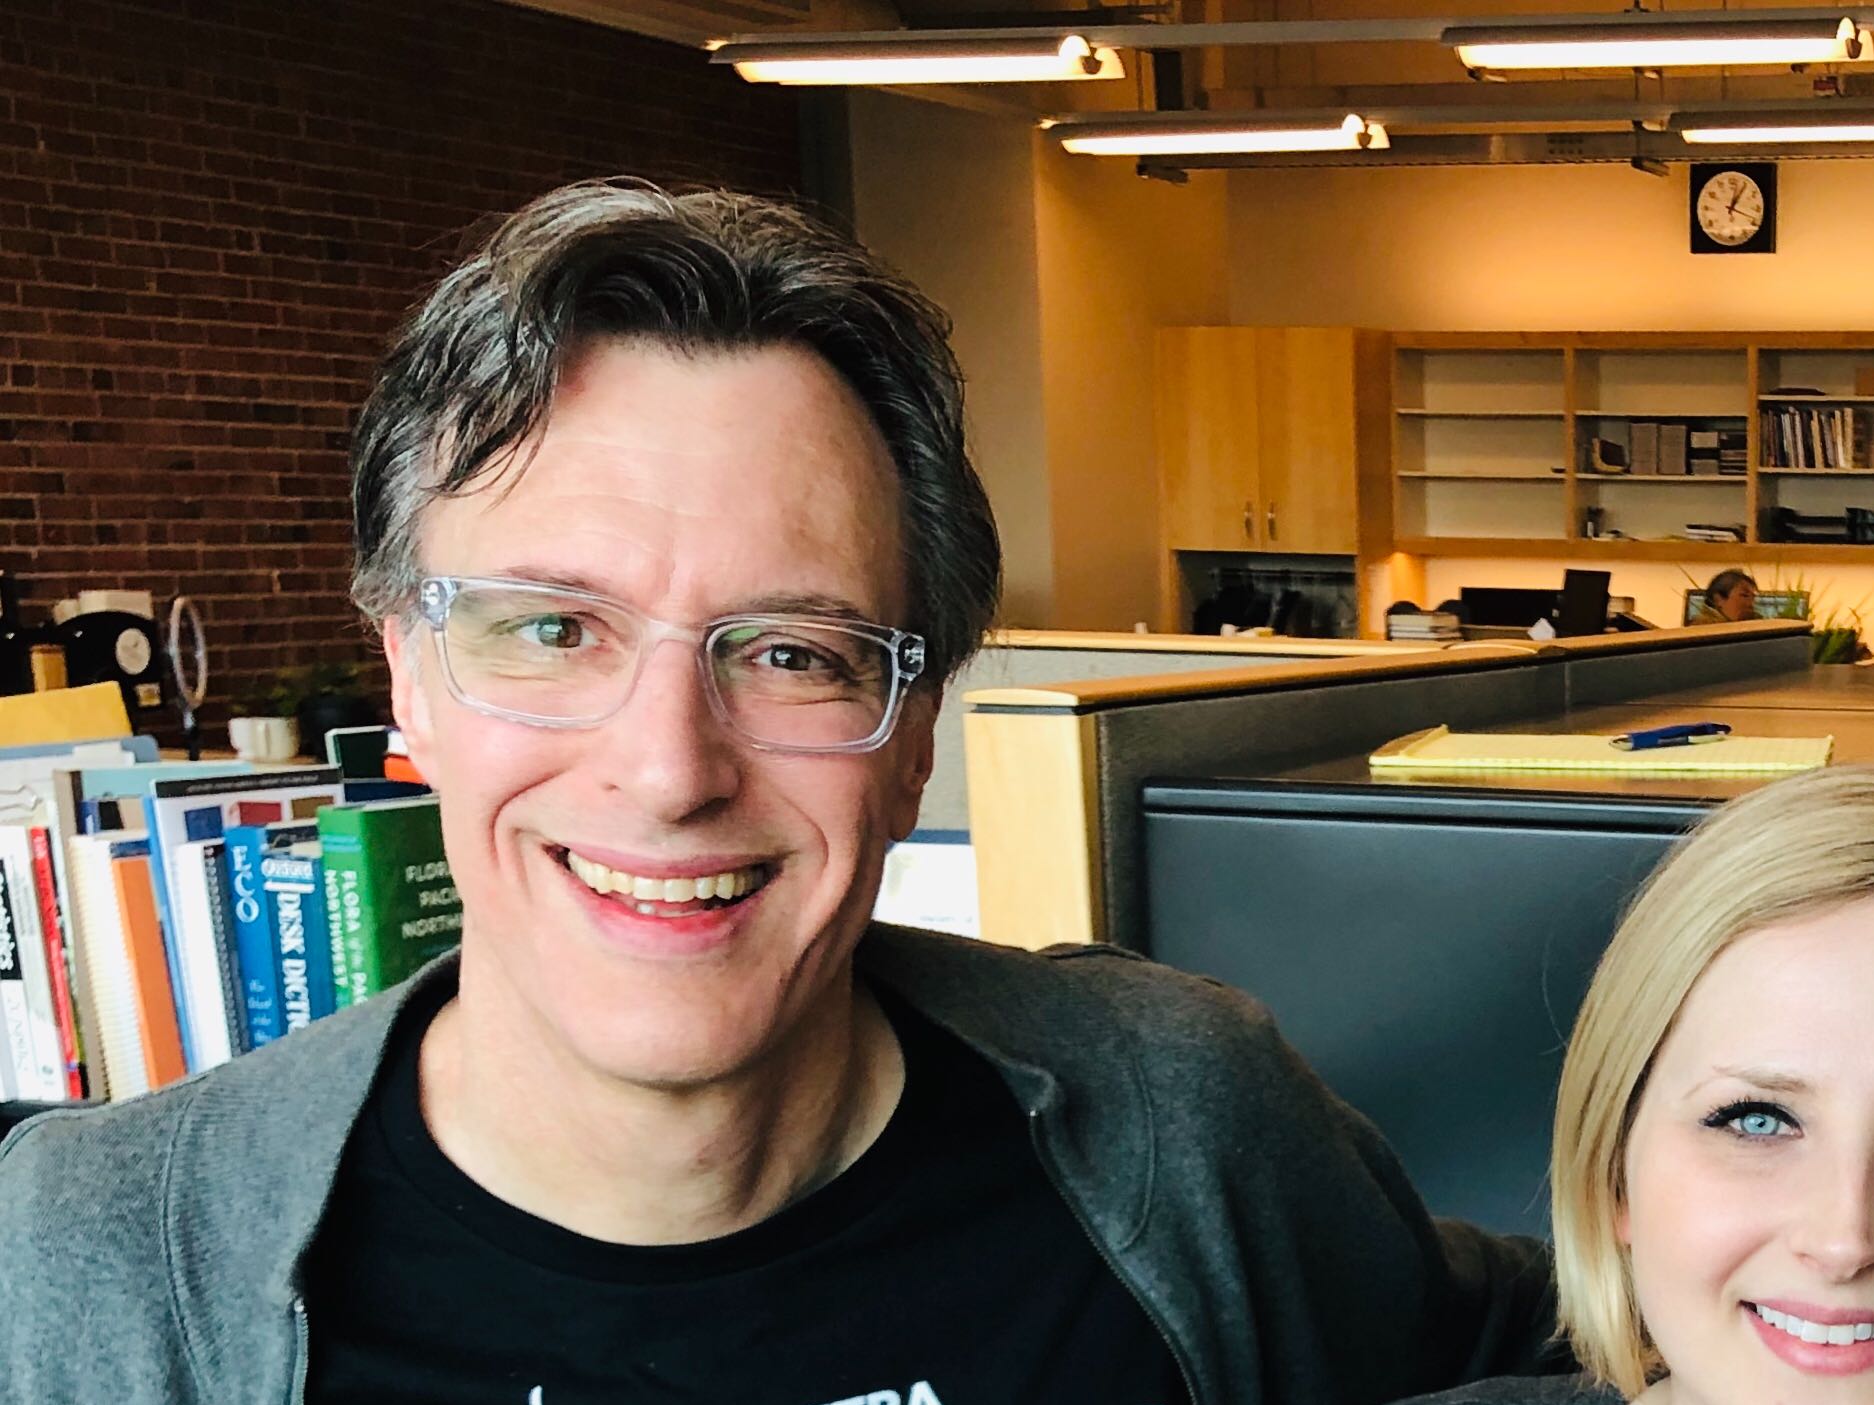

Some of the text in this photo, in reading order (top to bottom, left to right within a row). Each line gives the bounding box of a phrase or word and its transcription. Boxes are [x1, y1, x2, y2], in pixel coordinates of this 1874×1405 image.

[405, 861, 450, 883] FLOR
[277, 892, 306, 954] DESK
[324, 869, 349, 988] NORTHWEST
[341, 870, 361, 933] FLORA
[351, 971, 368, 1006] PAC
